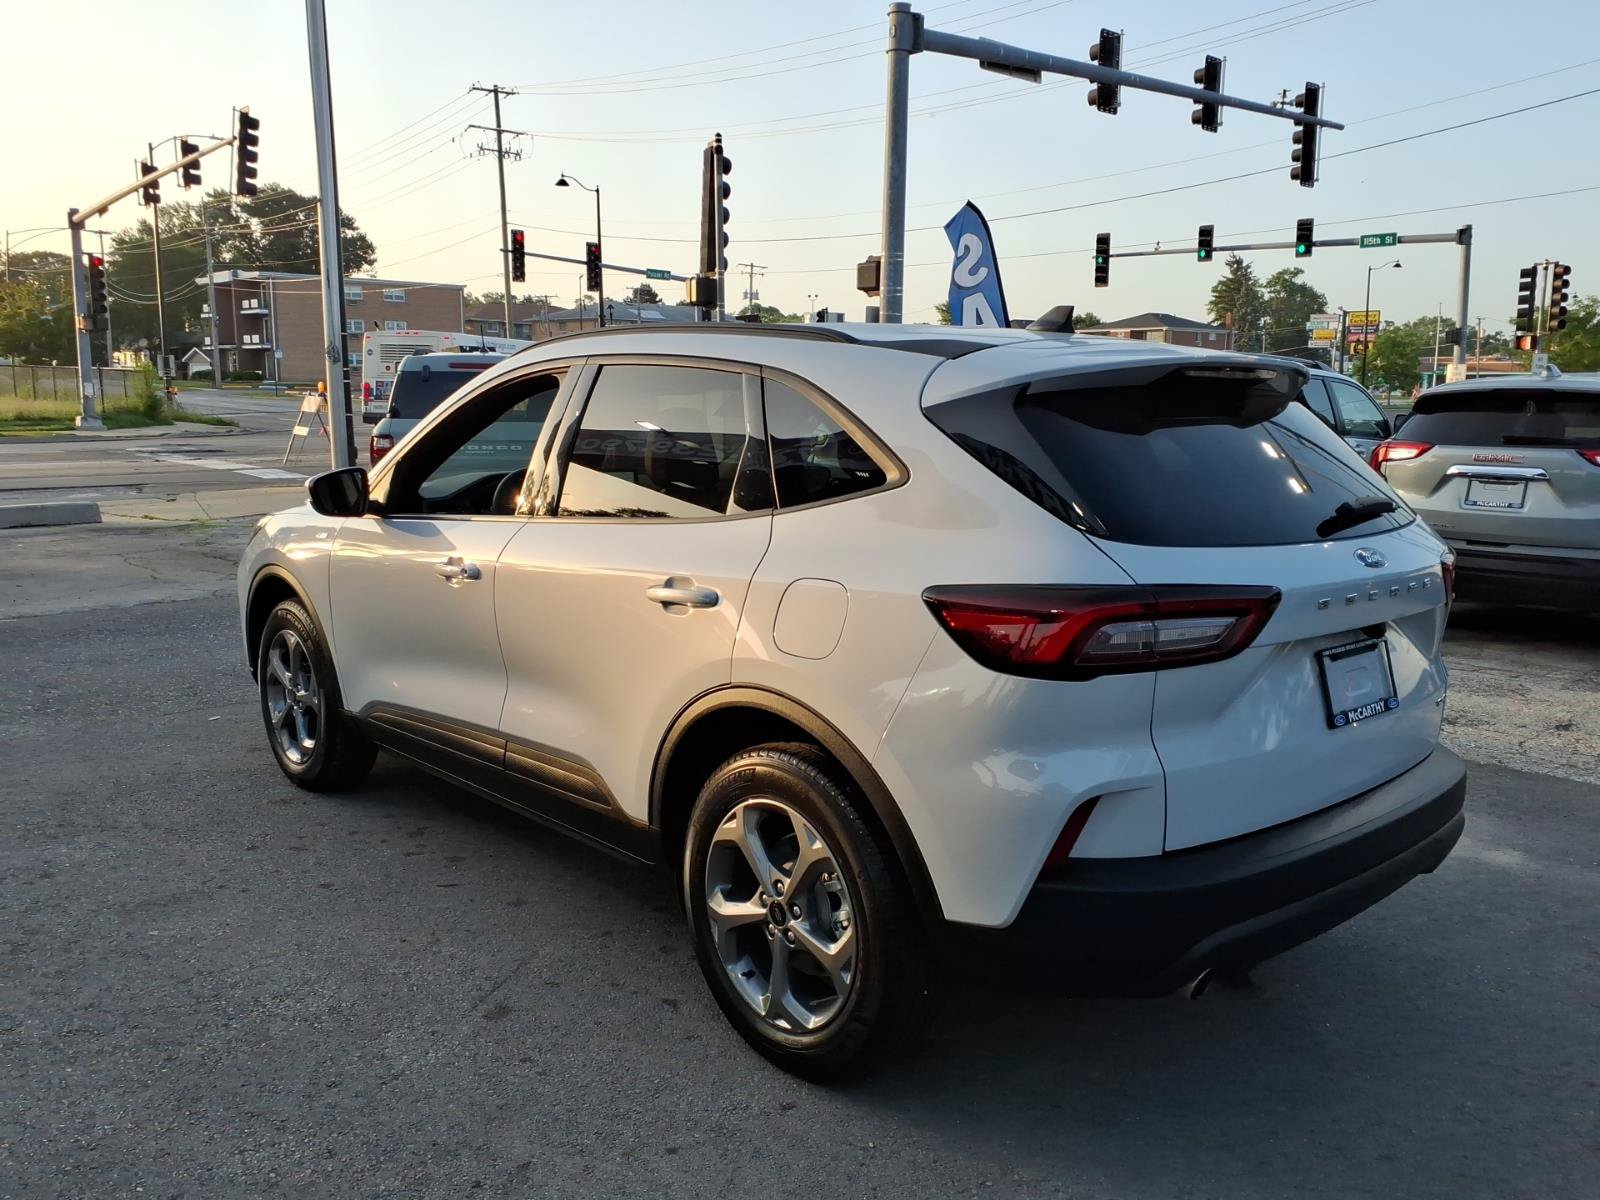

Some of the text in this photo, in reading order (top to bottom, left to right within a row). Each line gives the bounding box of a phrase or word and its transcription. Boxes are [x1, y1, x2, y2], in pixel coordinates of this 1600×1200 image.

[1363, 235, 1393, 246] 115th St
[1472, 453, 1523, 464] GMC
[1317, 577, 1432, 610] ESCAPE
[1348, 700, 1386, 723] McCARTHY
